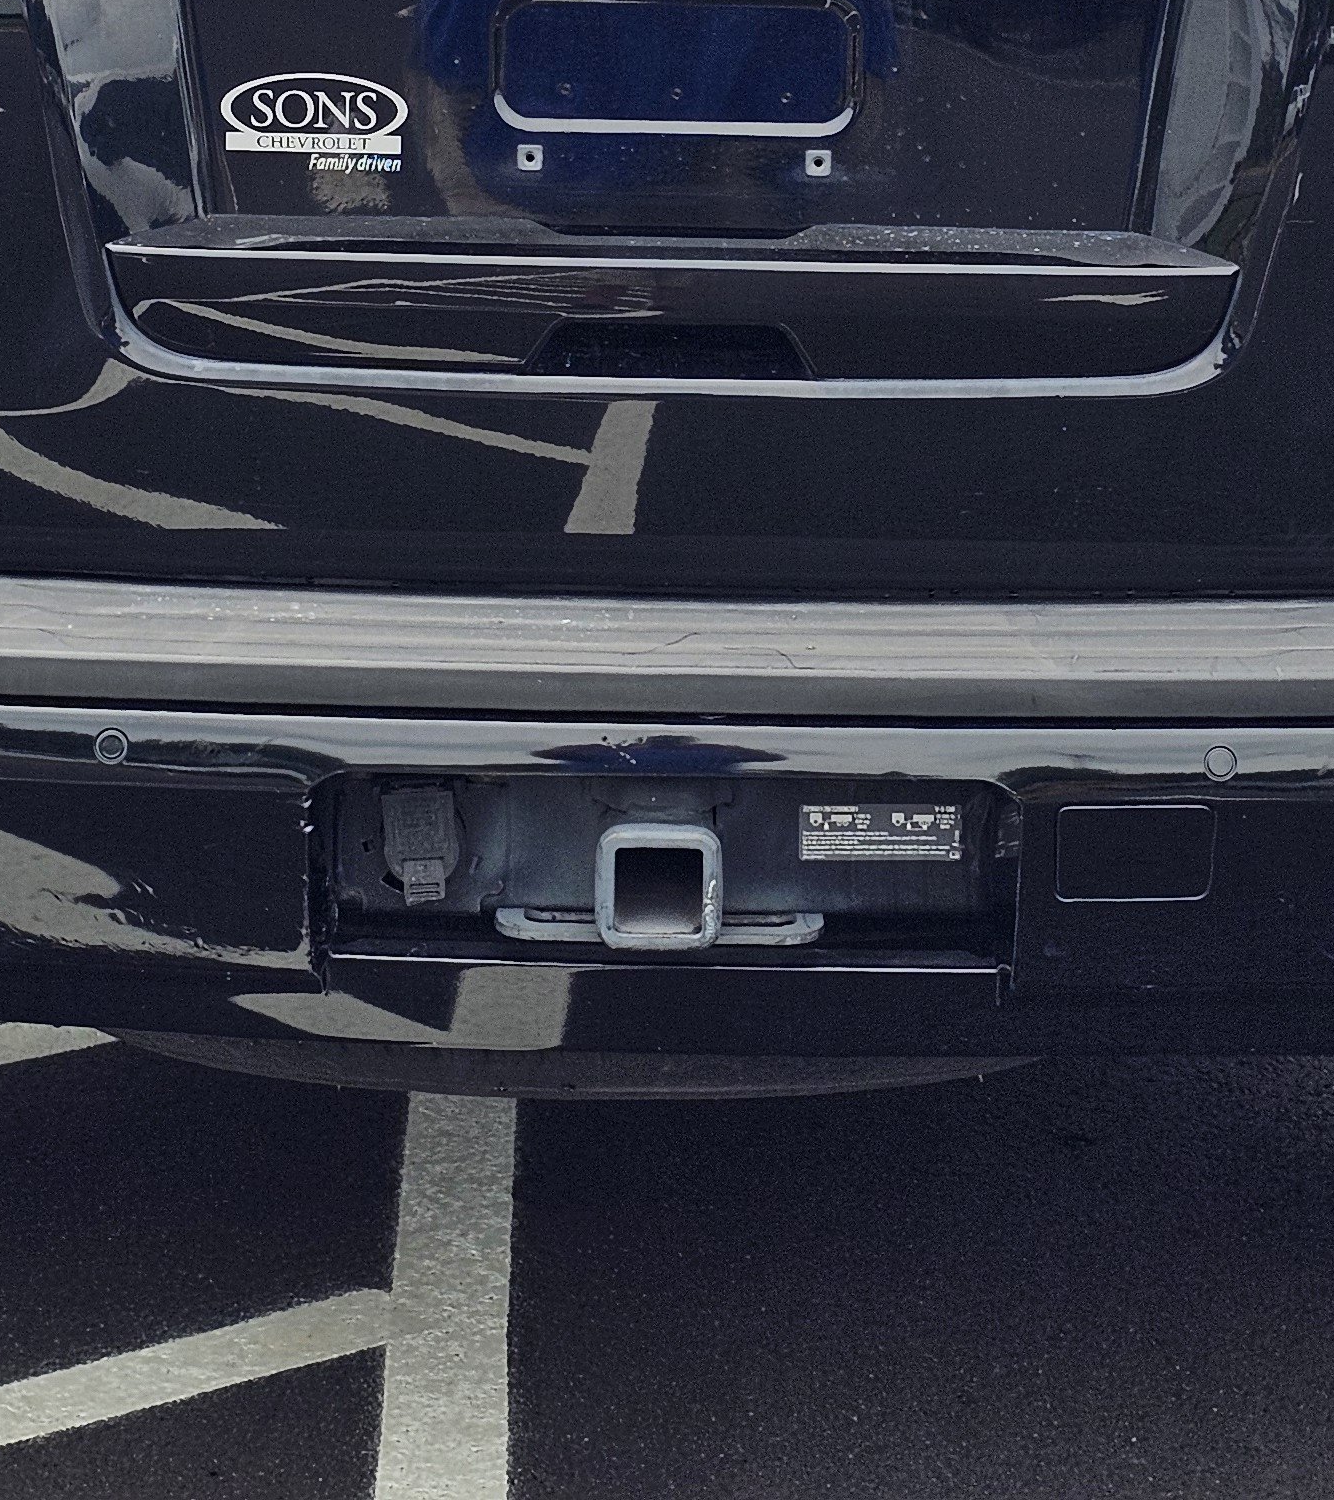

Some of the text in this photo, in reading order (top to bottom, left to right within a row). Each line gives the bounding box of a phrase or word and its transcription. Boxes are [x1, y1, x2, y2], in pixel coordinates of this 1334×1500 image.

[250, 89, 377, 130] SONS
[256, 135, 372, 151] CHEVROLET
[308, 154, 402, 175] Family driven
